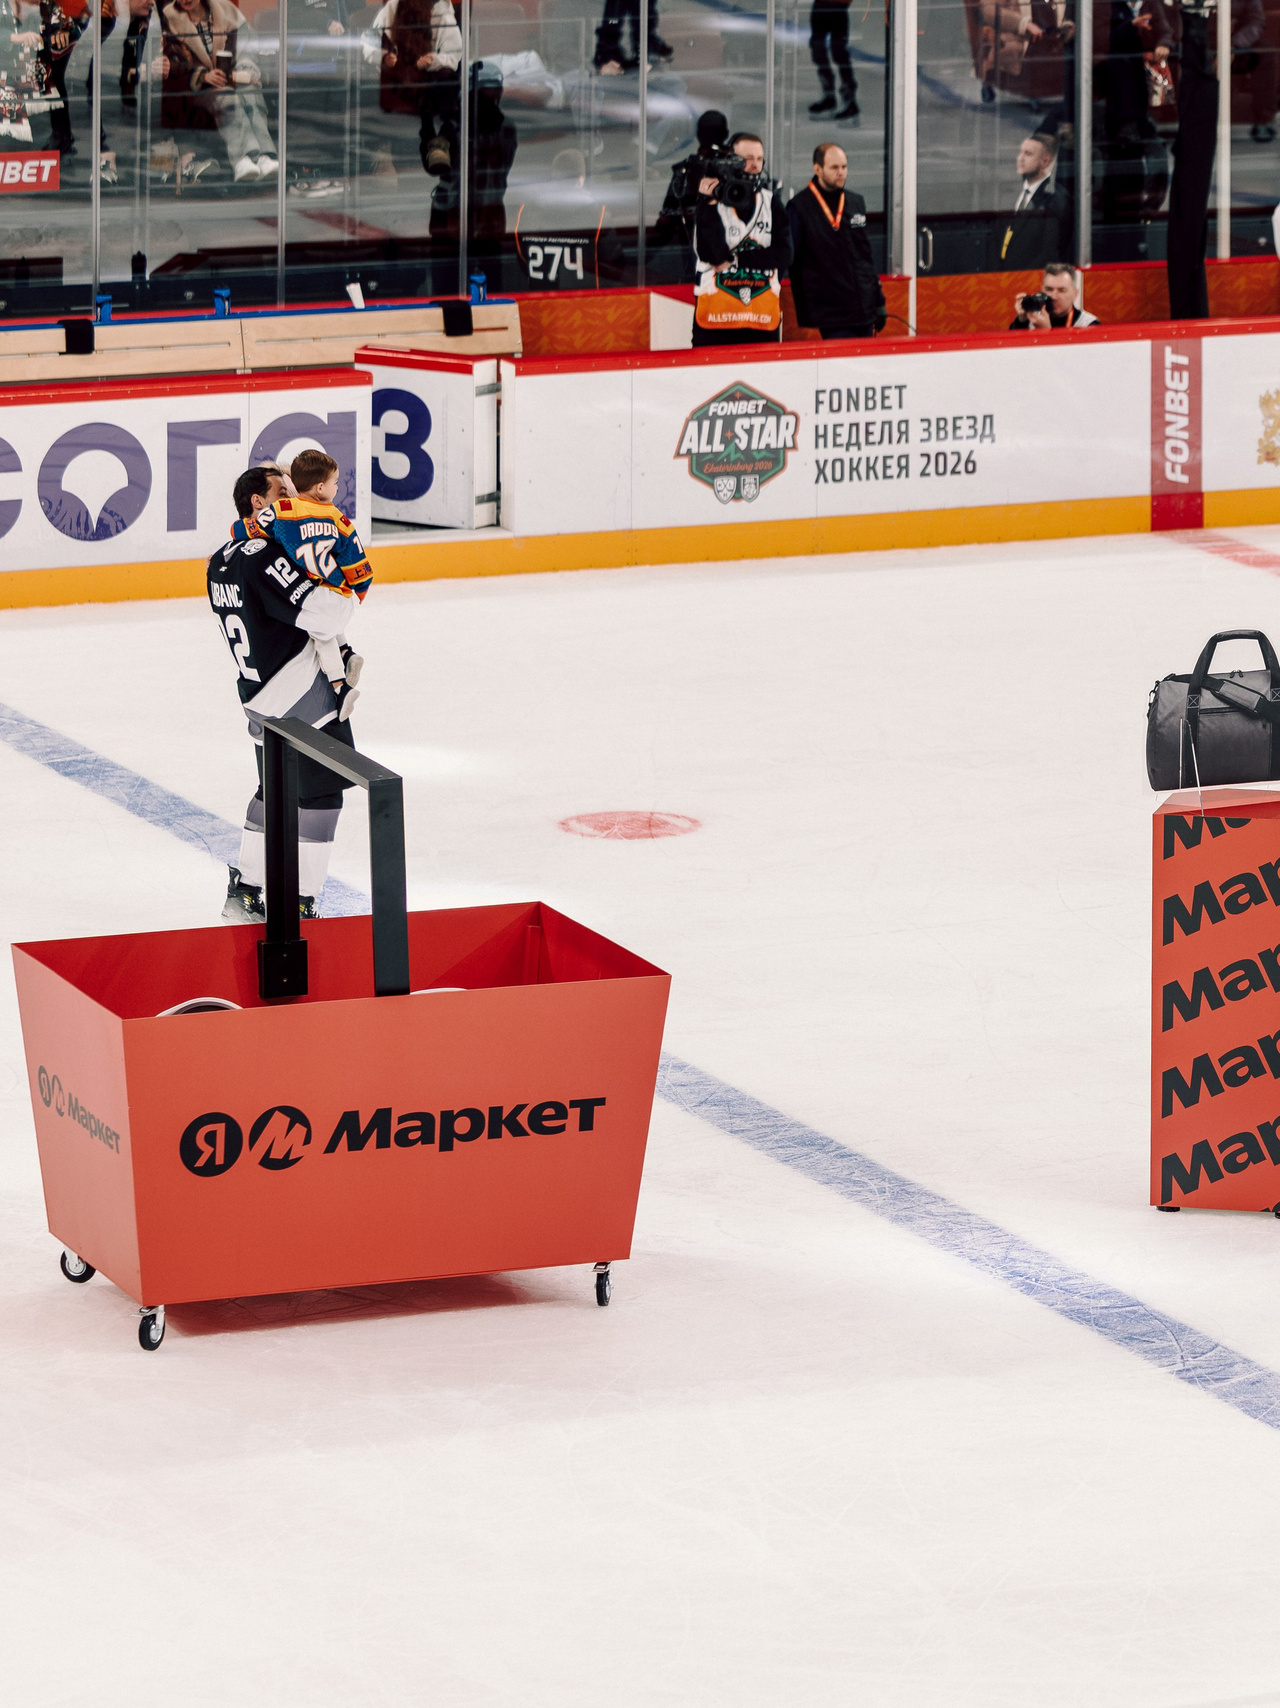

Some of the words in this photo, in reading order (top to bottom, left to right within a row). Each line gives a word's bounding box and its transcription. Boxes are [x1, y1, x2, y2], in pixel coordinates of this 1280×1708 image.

[0, 159, 57, 184] BET
[528, 245, 584, 281] 274
[708, 399, 767, 417] FONBET
[815, 385, 907, 415] FONBET
[1164, 346, 1189, 484] FONBET
[679, 418, 726, 455] ALL
[734, 414, 797, 451] STAR
[815, 419, 910, 452] НЕДЕЛЯ
[920, 414, 996, 444] ЗВЕЗД
[703, 460, 753, 474] Ekaterinburg
[815, 454, 910, 484] ХОККЕЯ
[919, 450, 977, 477] 2026
[300, 522, 339, 541] DADDY
[265, 556, 299, 589] 12
[67, 1092, 120, 1155] Маркет
[322, 1097, 606, 1154] Маркет
